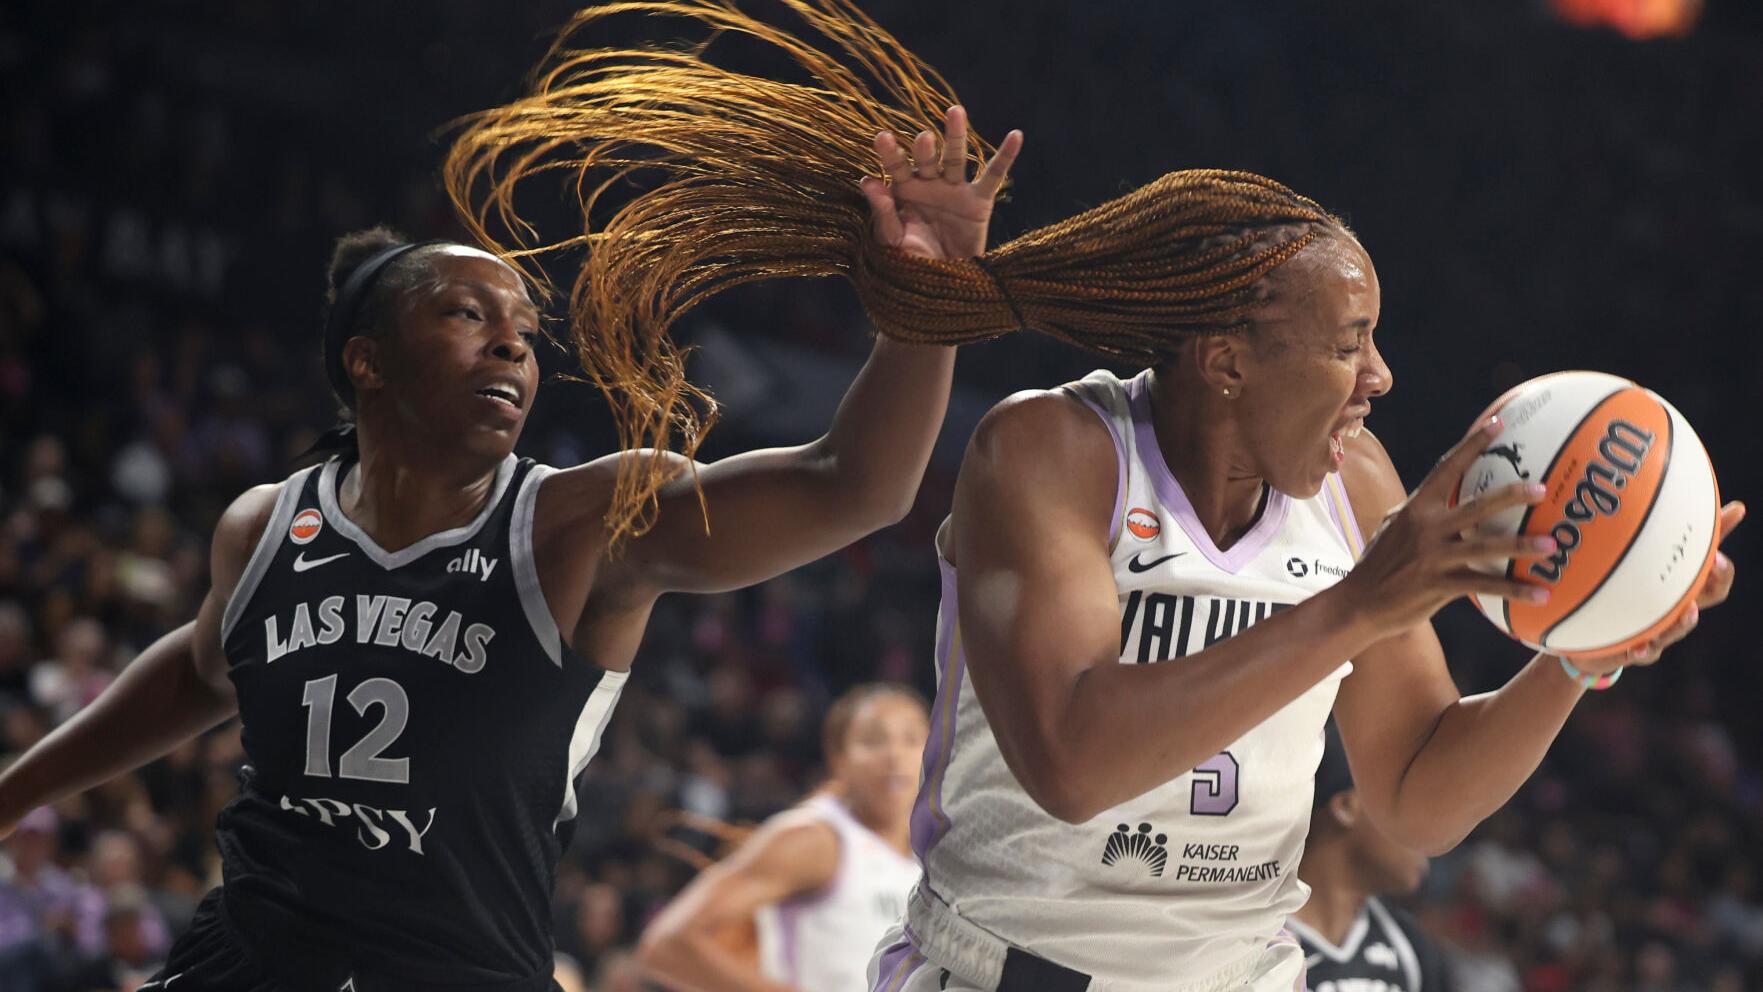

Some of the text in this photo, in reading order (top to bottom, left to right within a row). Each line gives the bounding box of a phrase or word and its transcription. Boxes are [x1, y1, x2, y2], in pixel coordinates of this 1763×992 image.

[1529, 416, 1656, 584] Wilson
[446, 548, 498, 582] ally
[265, 594, 496, 674] LAS VEGAS
[302, 673, 410, 784] 12
[1176, 860, 1281, 882] PERMANENTE
[1182, 843, 1239, 861] KAISER
